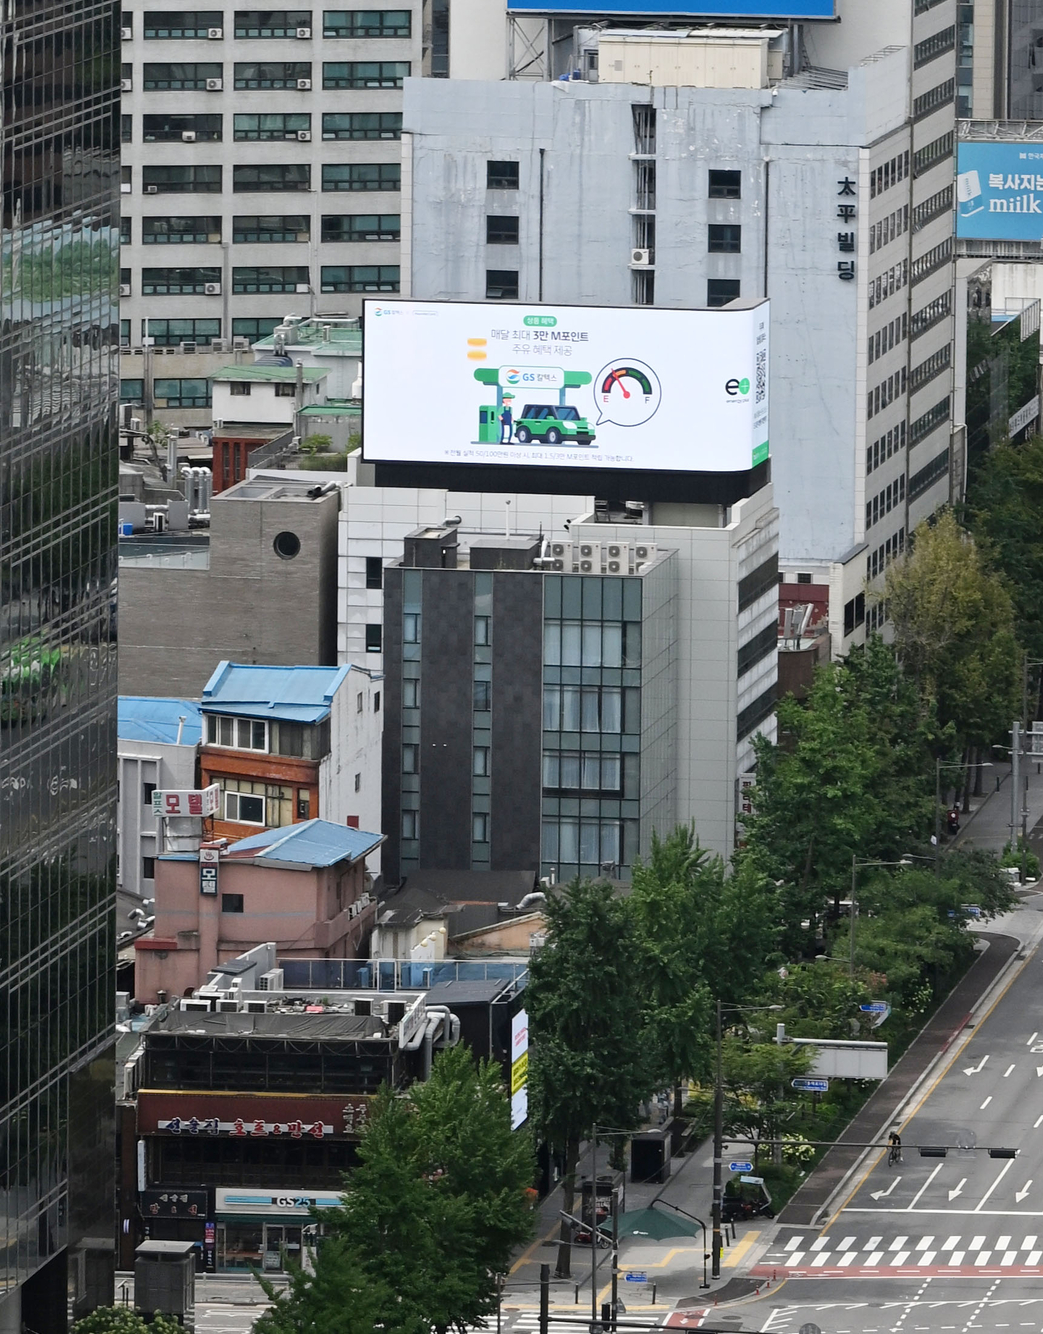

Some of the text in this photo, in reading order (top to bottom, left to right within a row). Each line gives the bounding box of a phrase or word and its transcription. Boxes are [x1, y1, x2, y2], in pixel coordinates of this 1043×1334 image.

[988, 193, 1043, 214] miilk
[533, 331, 549, 342] 3만
[551, 331, 589, 343] M포인트
[522, 373, 536, 382] GS
[603, 395, 609, 403] E
[645, 396, 650, 404] F
[165, 793, 203, 816] 모텔
[165, 1117, 220, 1136] 선술집
[276, 1196, 311, 1208] GS25
